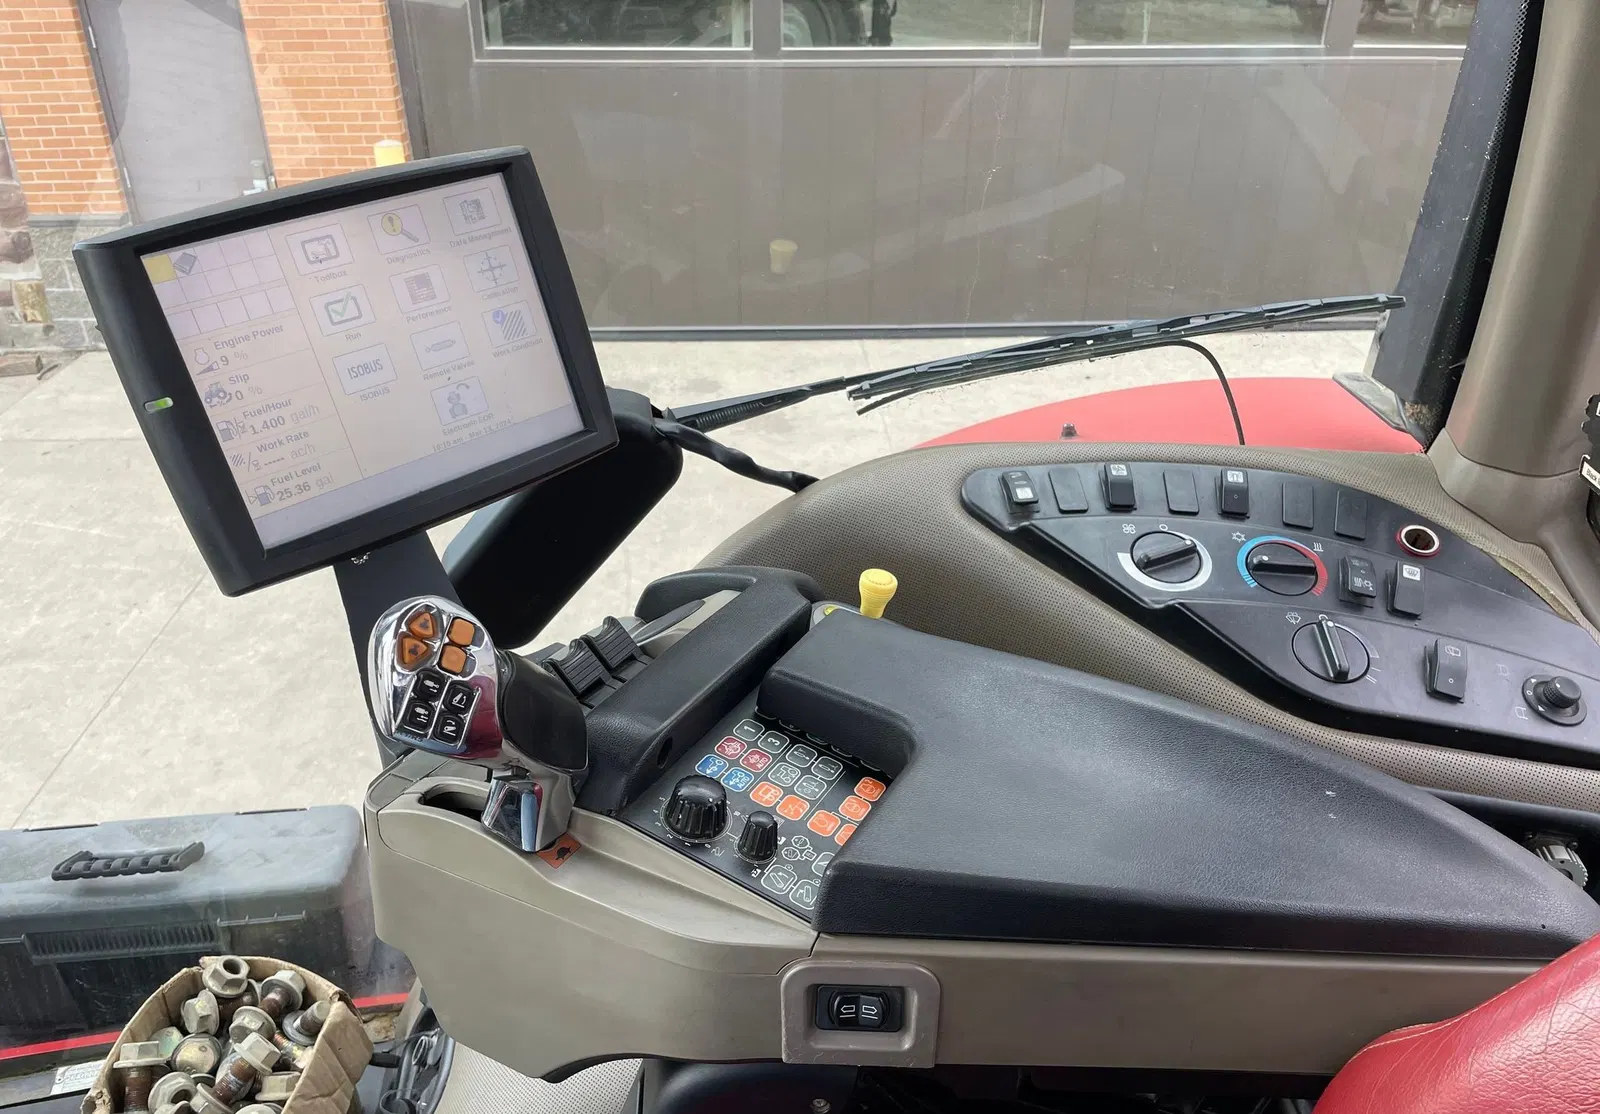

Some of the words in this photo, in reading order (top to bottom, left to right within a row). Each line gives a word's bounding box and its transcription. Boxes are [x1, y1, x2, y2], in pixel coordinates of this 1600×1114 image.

[386, 247, 431, 265] Diagnostics
[314, 270, 348, 283] Toolbox
[214, 334, 251, 351] Engine
[252, 324, 284, 340] Power
[345, 332, 361, 342] Run
[220, 355, 229, 366] 9
[347, 358, 383, 380] ISOBUS
[423, 366, 451, 381] Remote
[228, 373, 250, 385] Slip
[235, 390, 244, 401] 0
[360, 386, 390, 402] ISOBUS
[243, 399, 292, 419] Fuel/Hour
[249, 415, 285, 435] 1.400
[290, 404, 320, 425] gal/h
[257, 438, 285, 453] Work
[286, 430, 310, 444] Rate
[291, 443, 316, 460] ac/h
[270, 472, 294, 487] Fuel
[295, 462, 321, 478] Level
[276, 481, 311, 502] 25.36
[315, 472, 335, 490] gal
[744, 725, 755, 733] 1
[767, 737, 780, 746] 3
